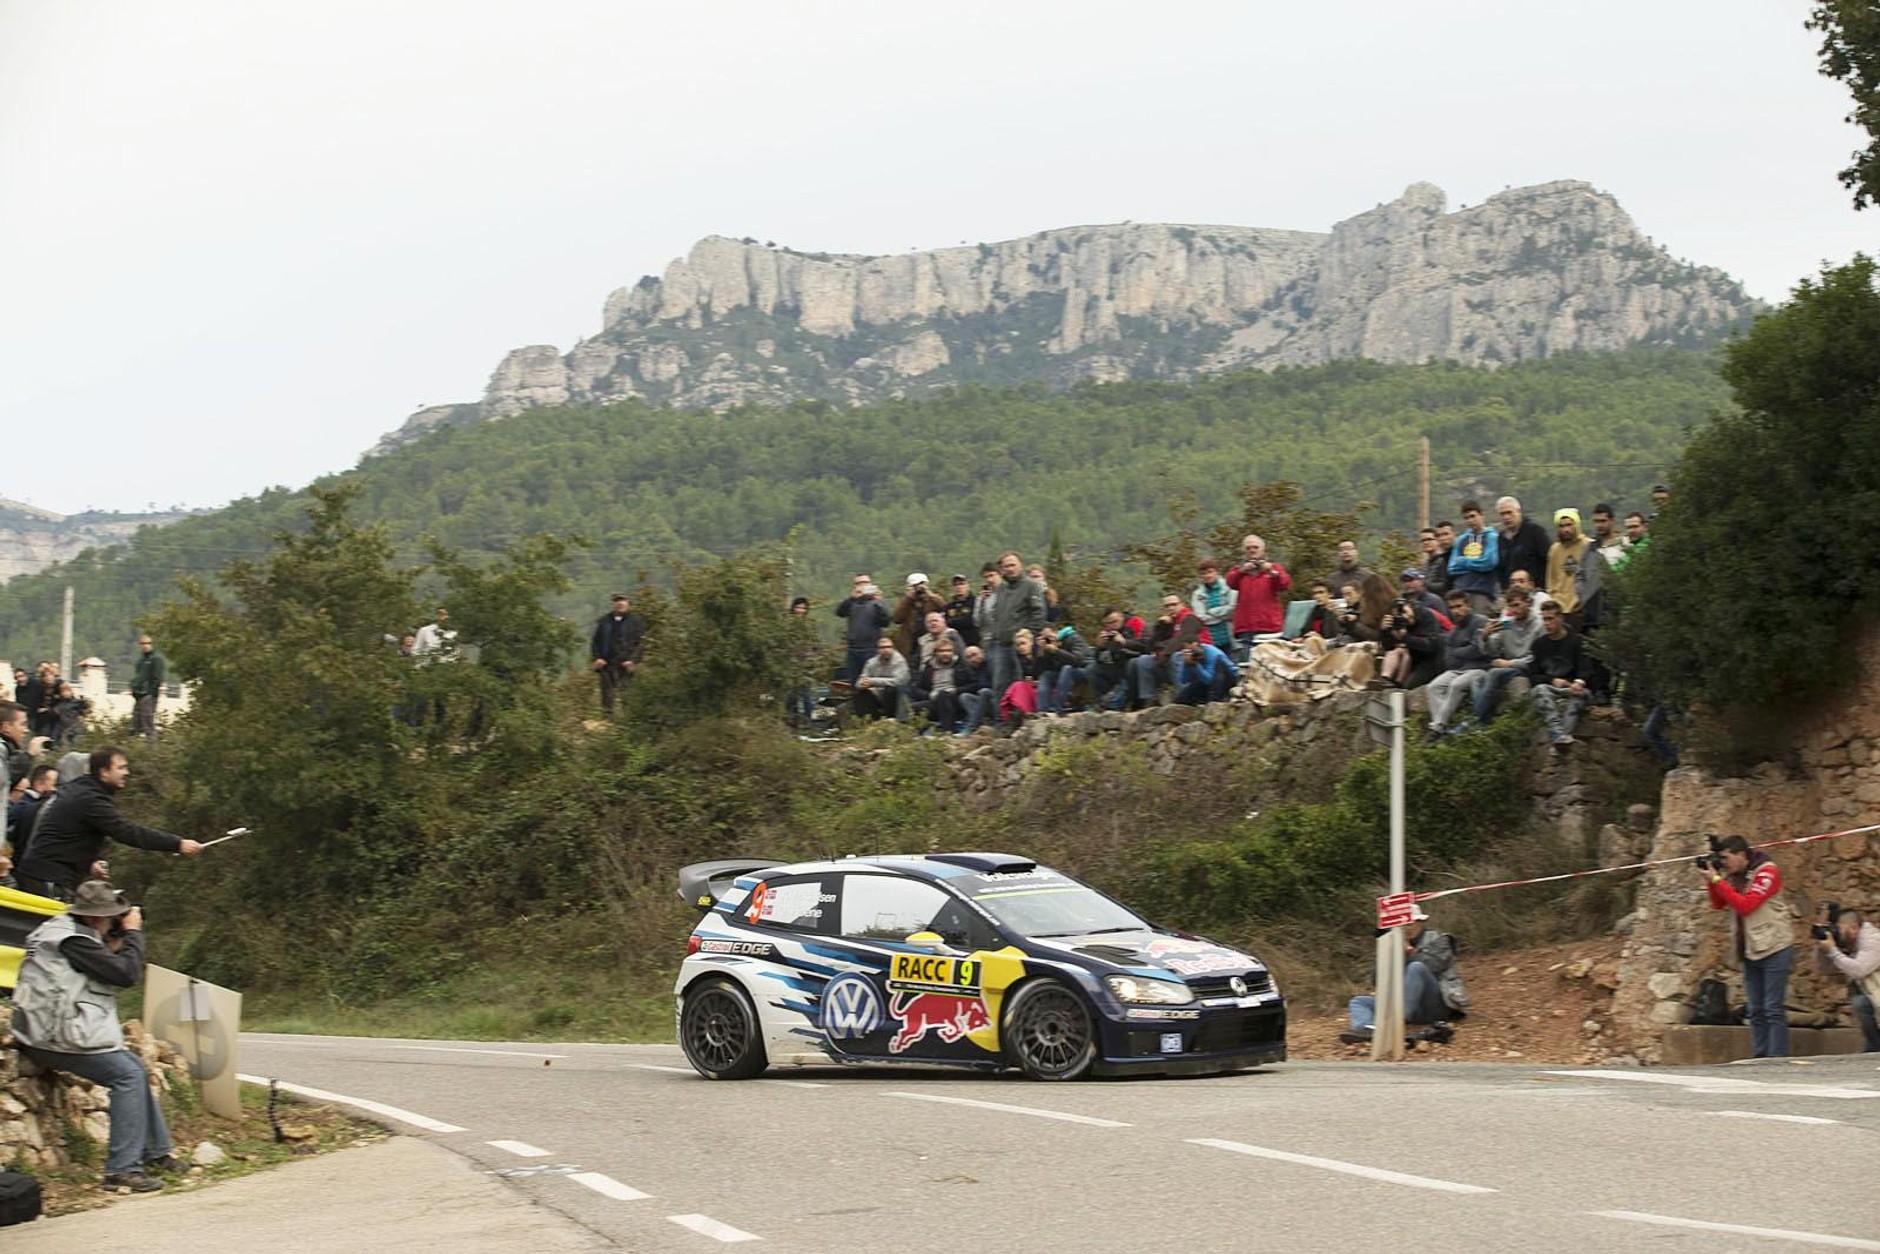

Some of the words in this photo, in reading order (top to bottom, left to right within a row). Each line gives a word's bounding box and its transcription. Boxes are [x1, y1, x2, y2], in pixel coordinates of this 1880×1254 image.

[750, 882, 768, 924] 9
[732, 942, 773, 956] EDGE
[897, 957, 946, 982] RACC
[960, 961, 974, 986] 9
